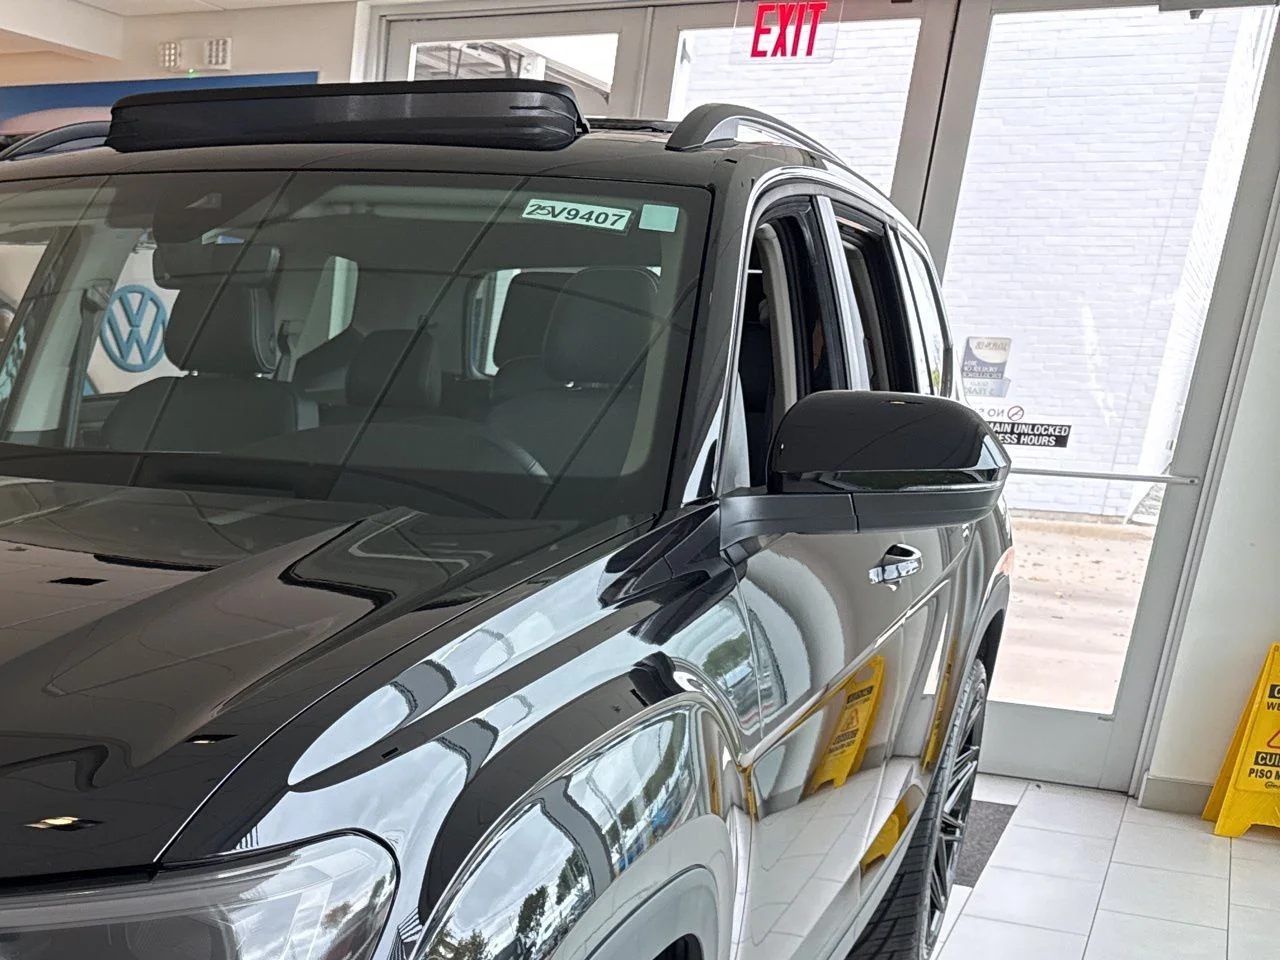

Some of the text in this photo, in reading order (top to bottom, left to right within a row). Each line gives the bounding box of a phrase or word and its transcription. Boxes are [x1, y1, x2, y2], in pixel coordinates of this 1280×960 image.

[750, 2, 828, 57] EXIT
[525, 203, 626, 227] 25V9407
[1013, 424, 1069, 436] UNLOCKED
[1020, 435, 1056, 446] HOURS
[1248, 768, 1273, 780] PISO
